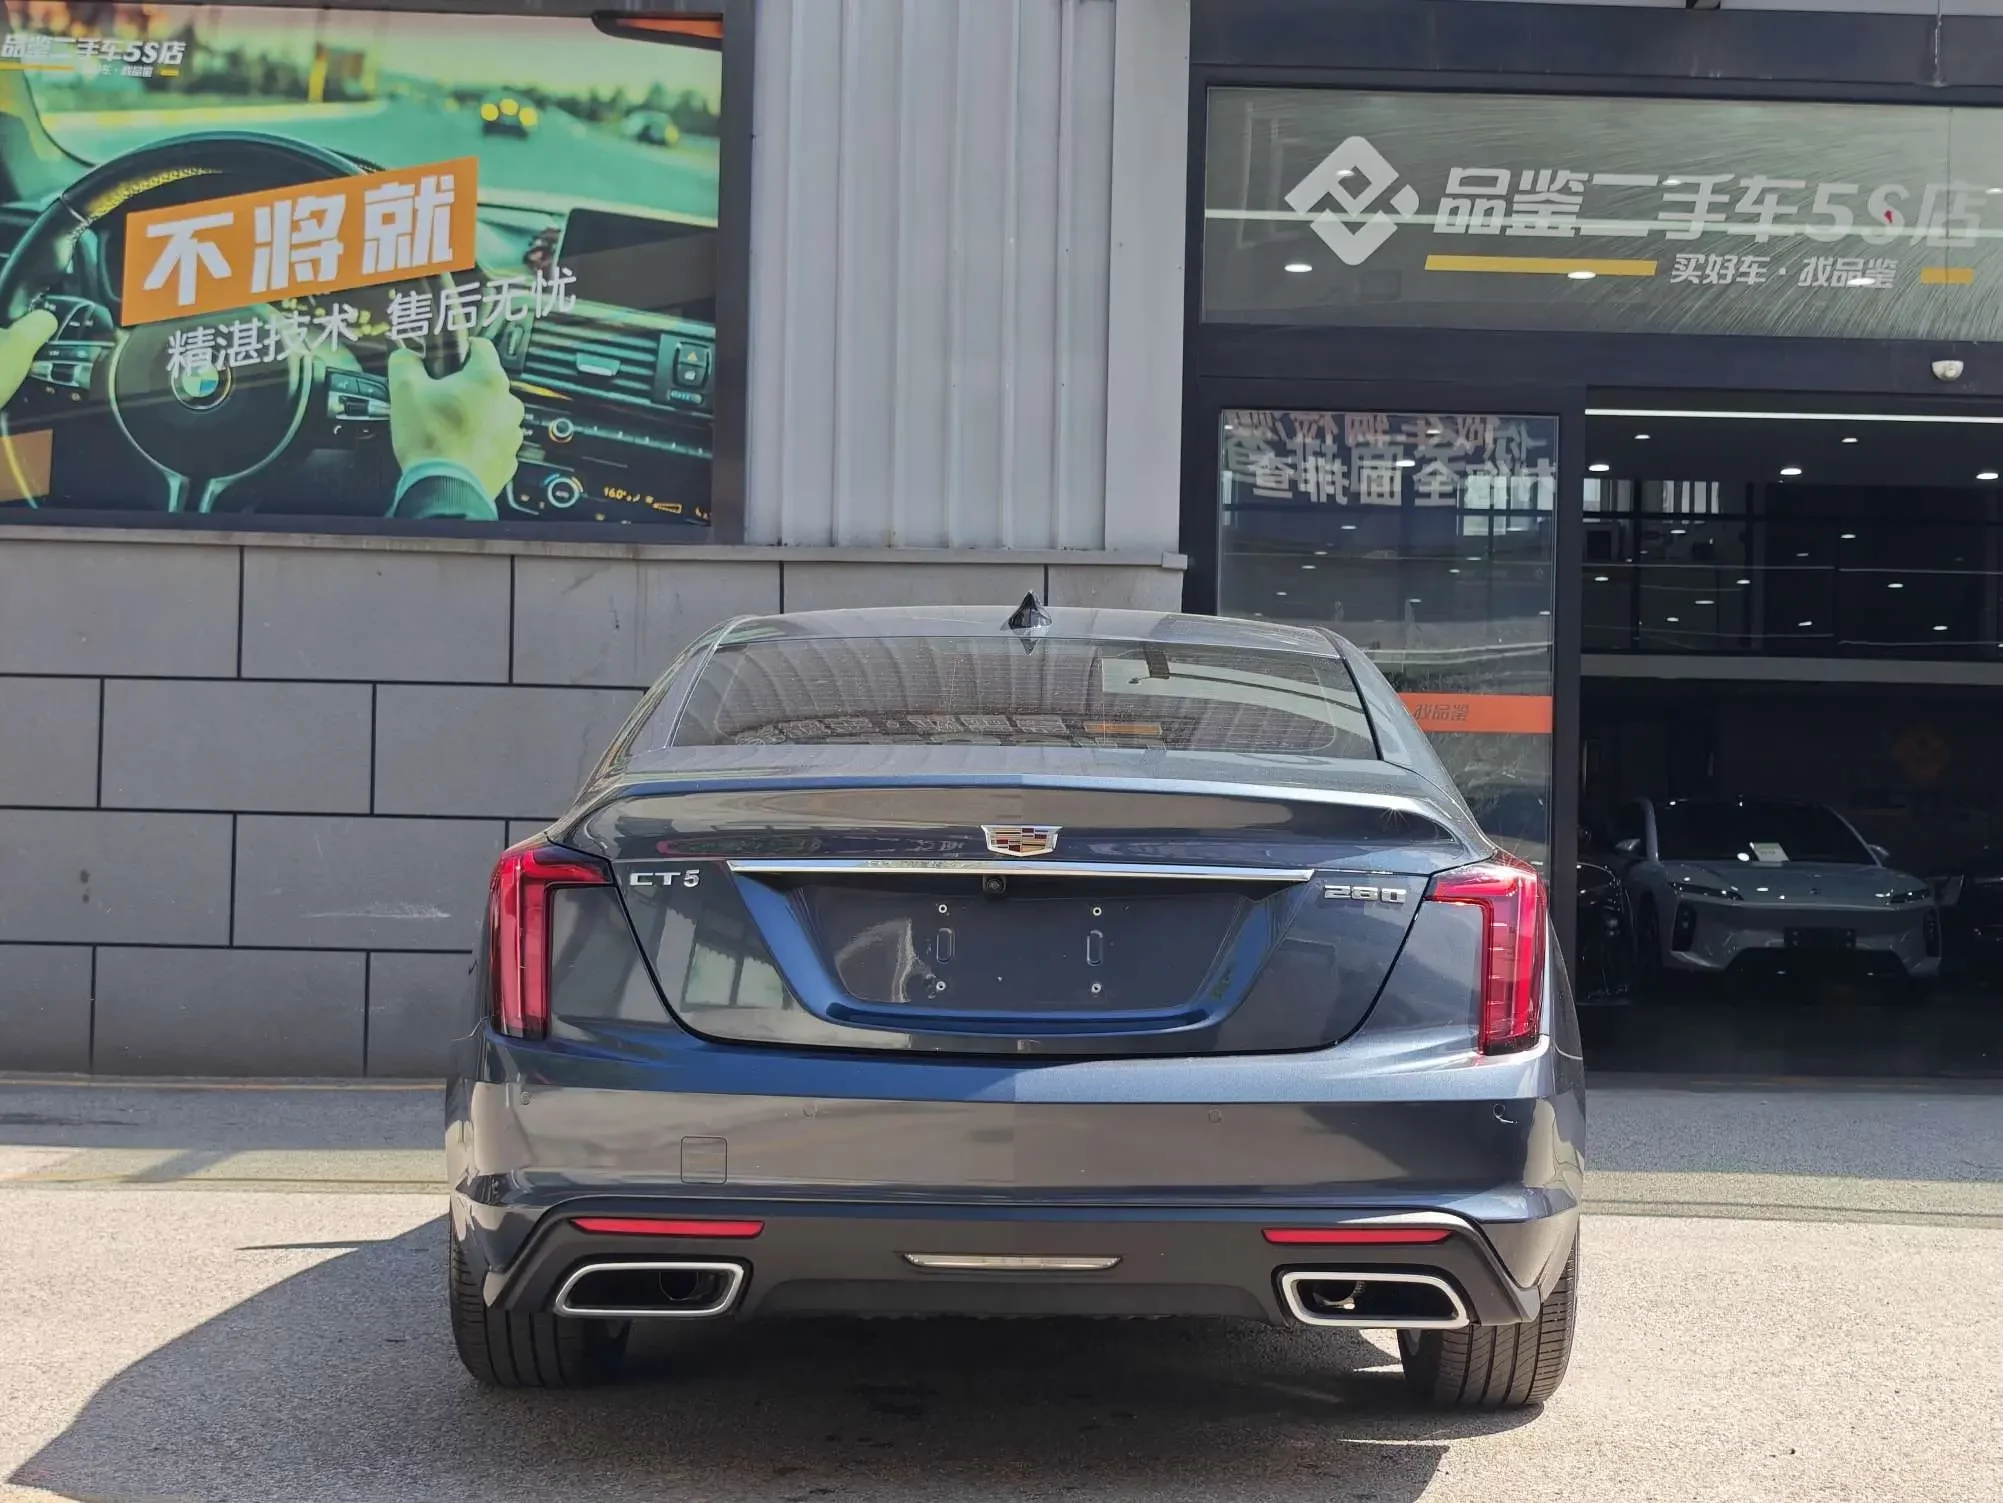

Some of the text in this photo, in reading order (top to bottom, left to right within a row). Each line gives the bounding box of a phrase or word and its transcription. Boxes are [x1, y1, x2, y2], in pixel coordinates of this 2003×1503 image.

[143, 173, 456, 307] 不将就
[1433, 166, 1987, 246] 品鉴二手车5S店
[166, 267, 578, 376] 精湛技术 售后无忧
[629, 869, 700, 888] CT5
